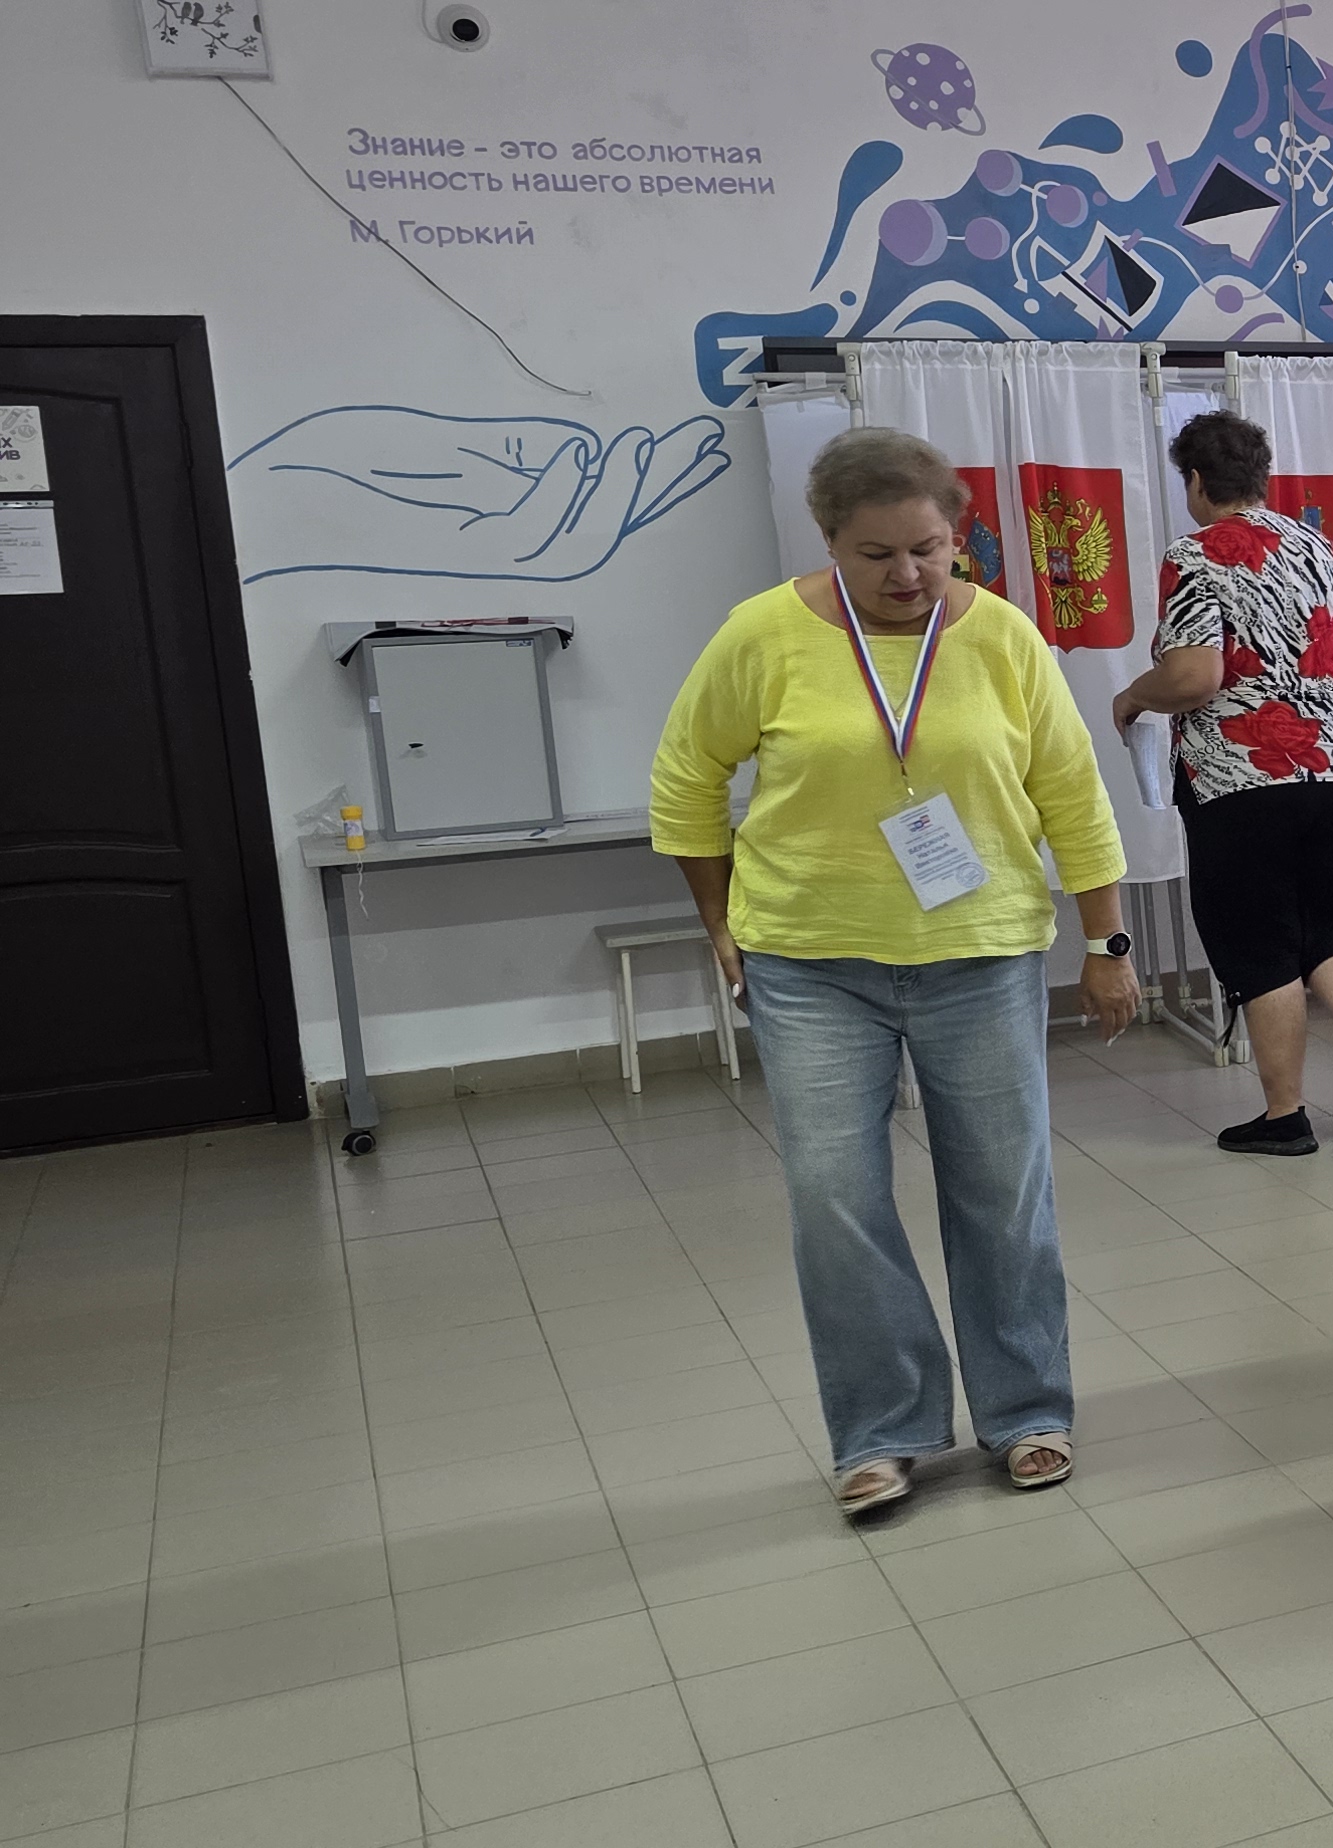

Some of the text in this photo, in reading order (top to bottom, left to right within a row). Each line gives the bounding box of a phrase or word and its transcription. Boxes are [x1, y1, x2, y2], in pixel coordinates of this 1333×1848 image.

[347, 128, 465, 158] Знание
[501, 139, 557, 161] это
[571, 137, 763, 165] абсолютная
[345, 168, 776, 197] ценность нашего времени
[398, 220, 535, 248] Горький
